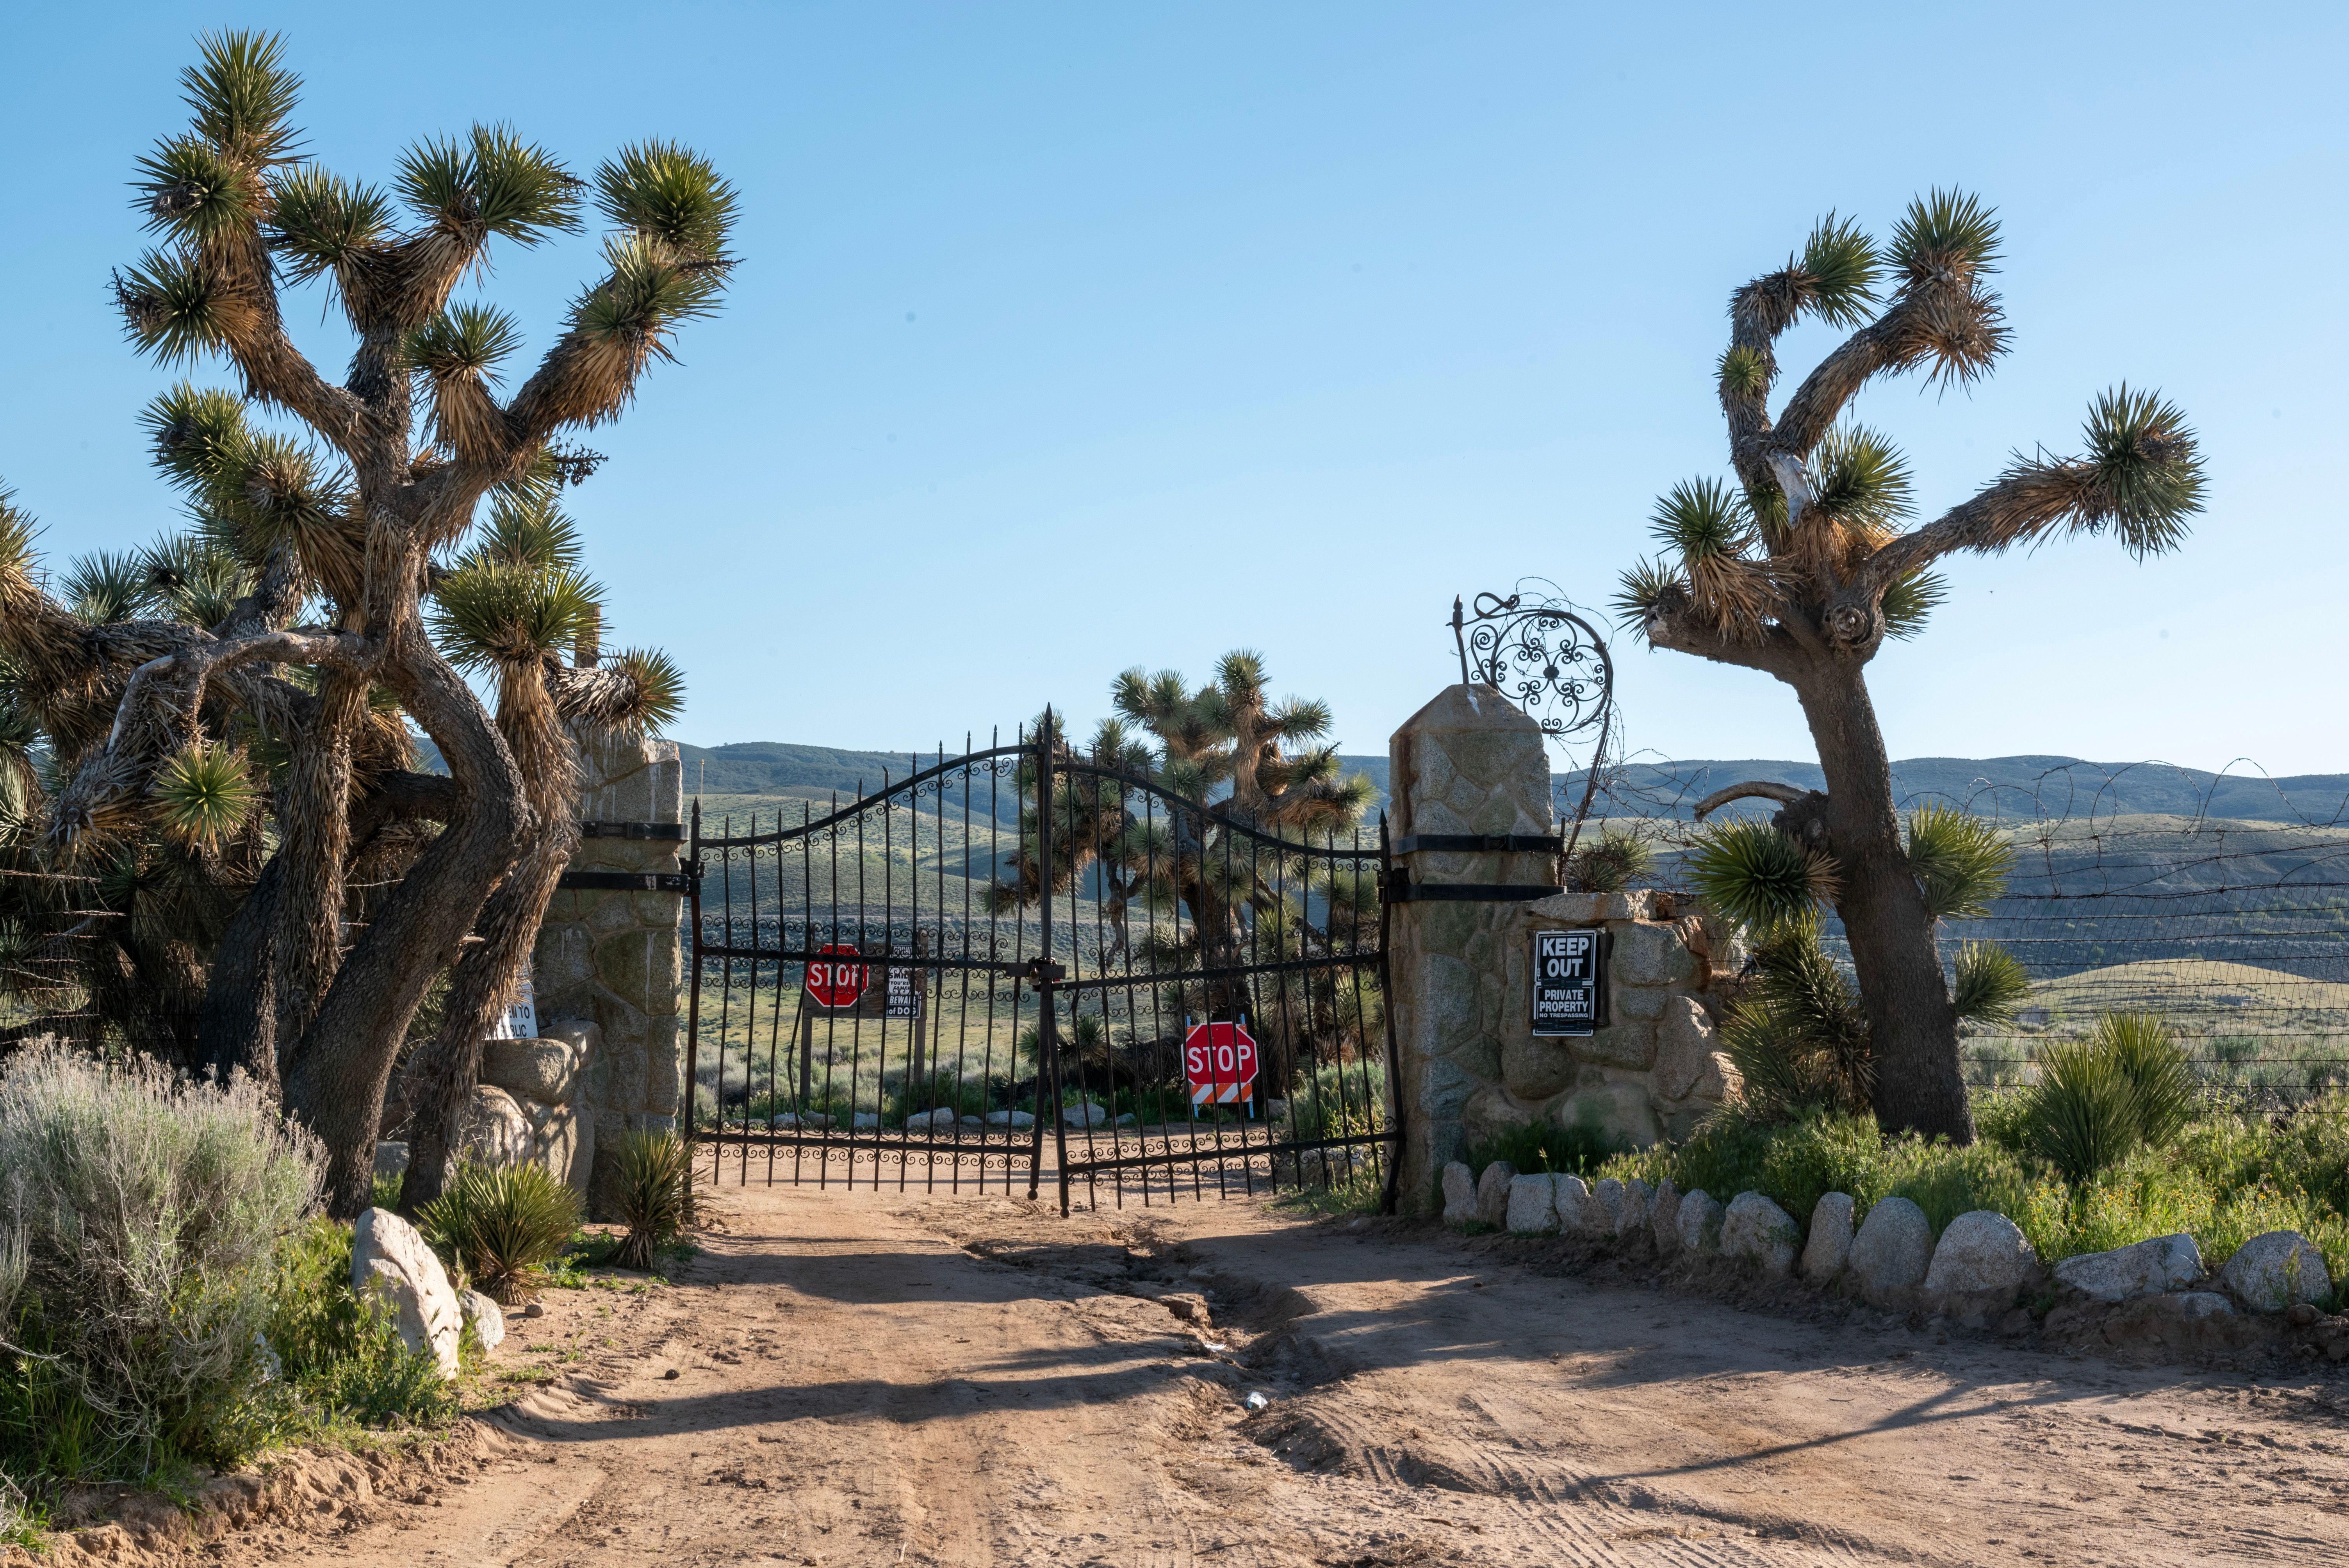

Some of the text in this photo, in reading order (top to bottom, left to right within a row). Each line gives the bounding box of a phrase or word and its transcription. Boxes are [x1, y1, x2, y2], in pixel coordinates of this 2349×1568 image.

[1543, 937, 1589, 956] KEEP
[1547, 959, 1583, 977] OUT
[1545, 990, 1584, 1000] PRIVATE
[518, 1006, 530, 1019] TO
[1540, 1001, 1588, 1012] PROPERTY
[1188, 1045, 1251, 1073] STOP
